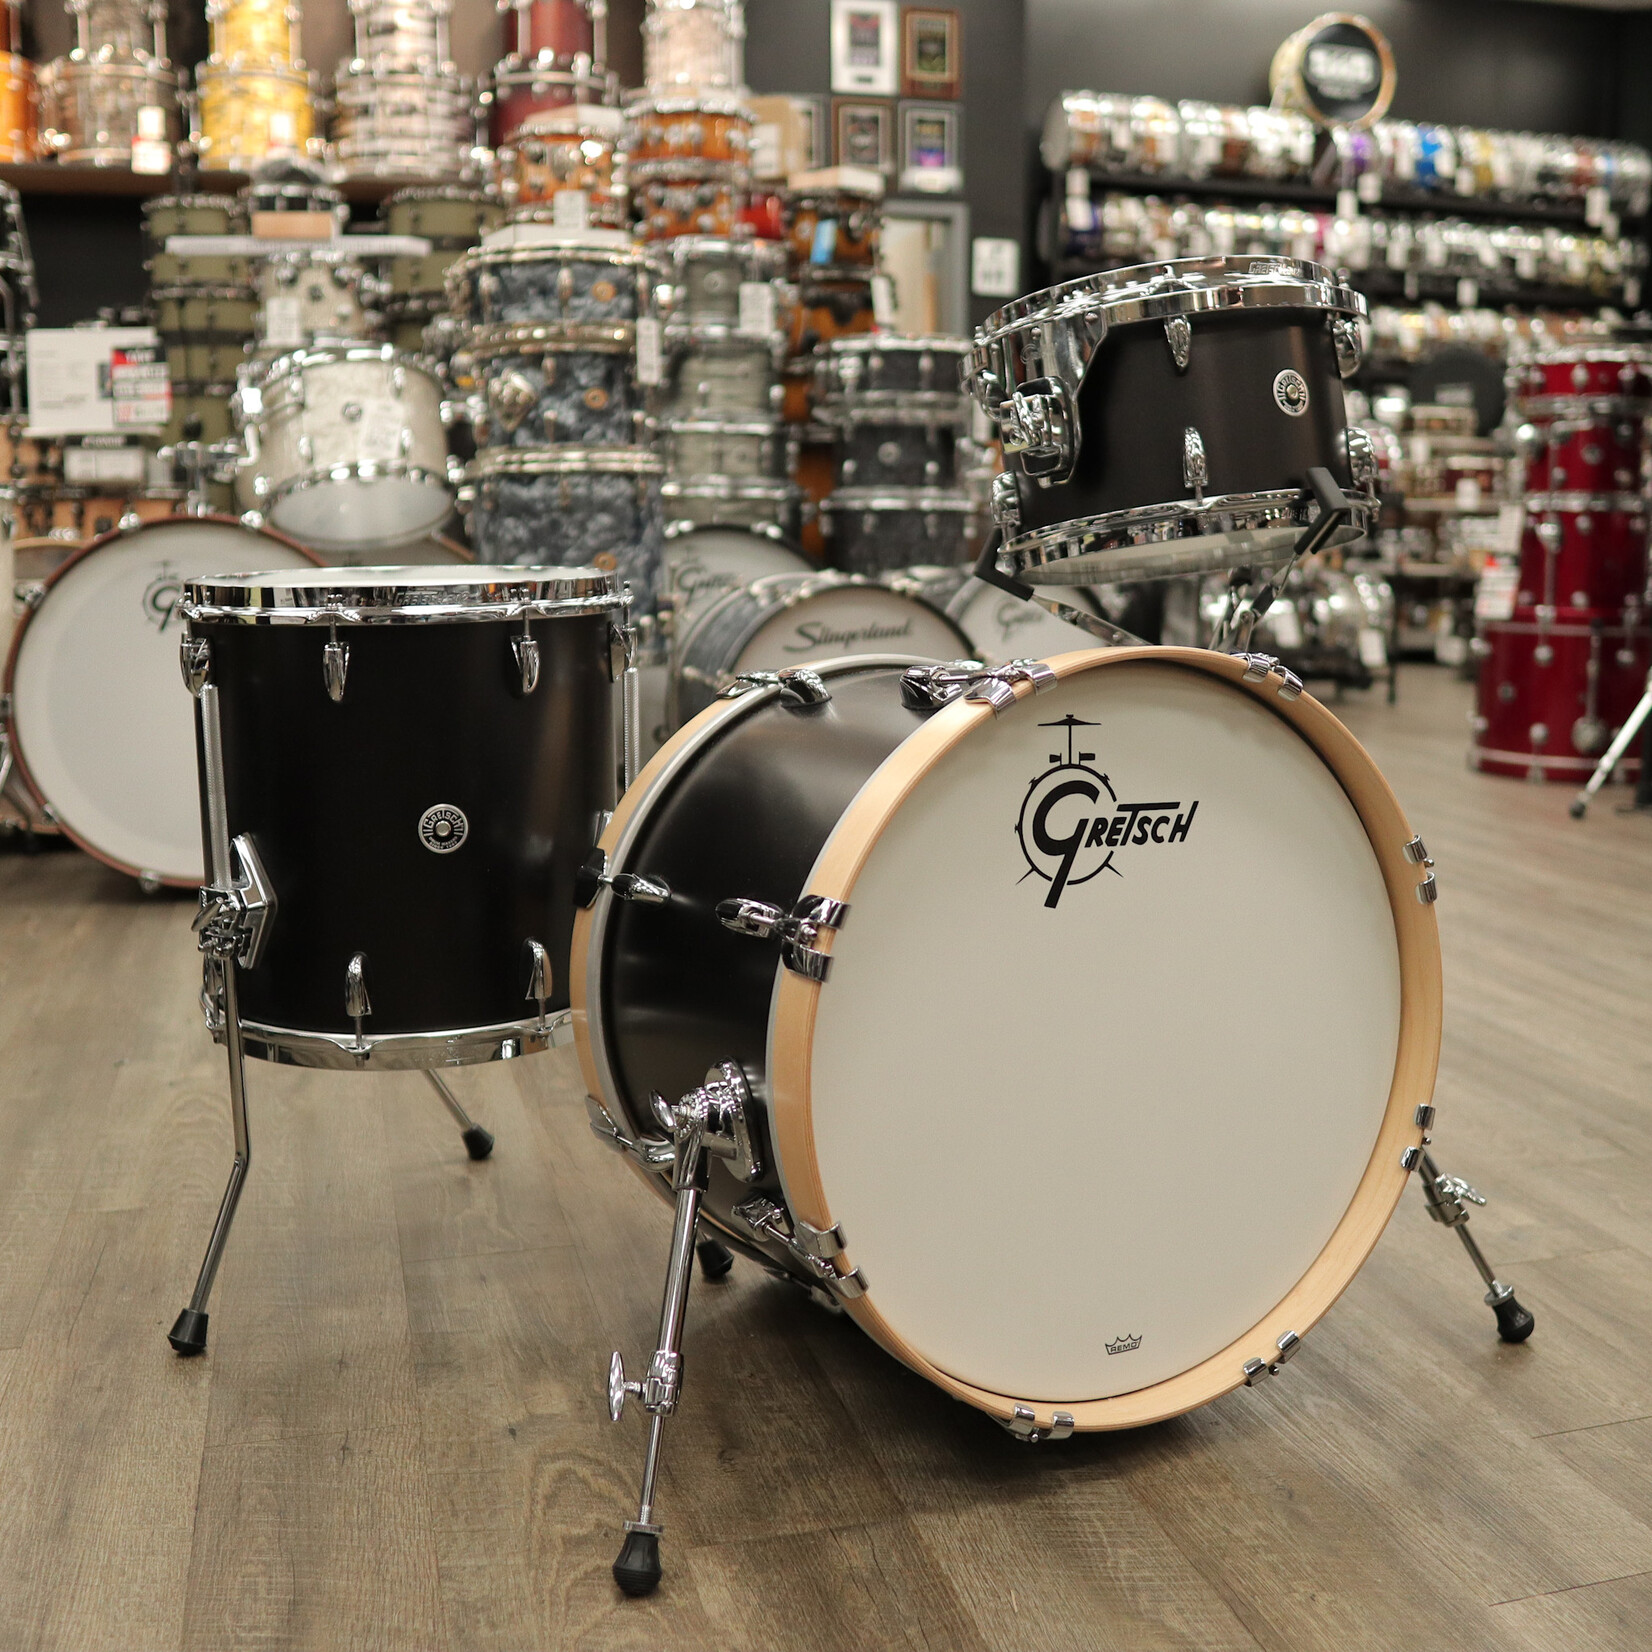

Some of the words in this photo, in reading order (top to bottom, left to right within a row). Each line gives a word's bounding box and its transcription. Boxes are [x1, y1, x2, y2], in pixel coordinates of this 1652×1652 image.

[423, 809, 464, 829] GRETSCH
[1033, 780, 1199, 909] GRETSCH
[1110, 1342, 1138, 1353] REMO
